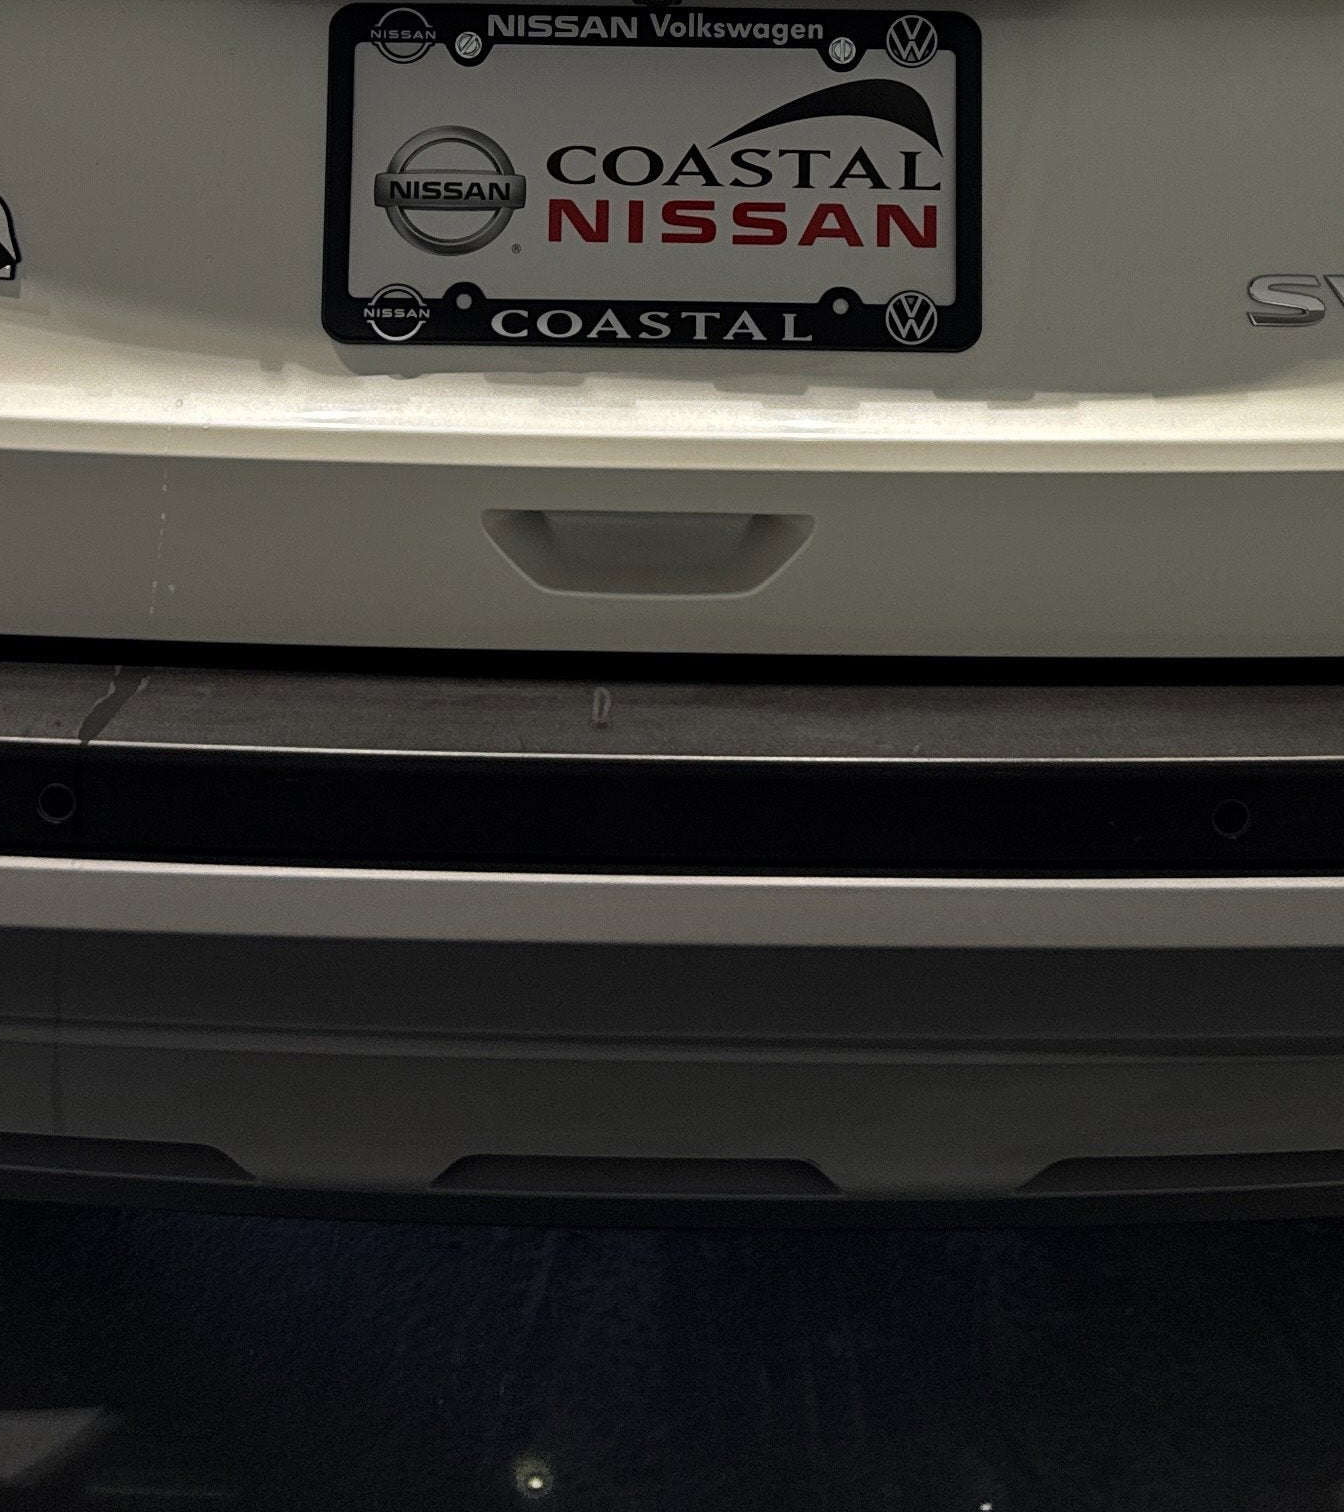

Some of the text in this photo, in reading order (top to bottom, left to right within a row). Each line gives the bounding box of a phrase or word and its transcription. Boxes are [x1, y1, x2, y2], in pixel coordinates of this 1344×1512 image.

[370, 29, 436, 40] NISSAN
[488, 14, 824, 44] NISSAN Volkswagen
[546, 144, 942, 191] COASTAL
[390, 180, 511, 201] NISSAN
[547, 199, 938, 249] NISSAN
[364, 308, 431, 319] NISSAN
[491, 309, 813, 342] COASTAL
